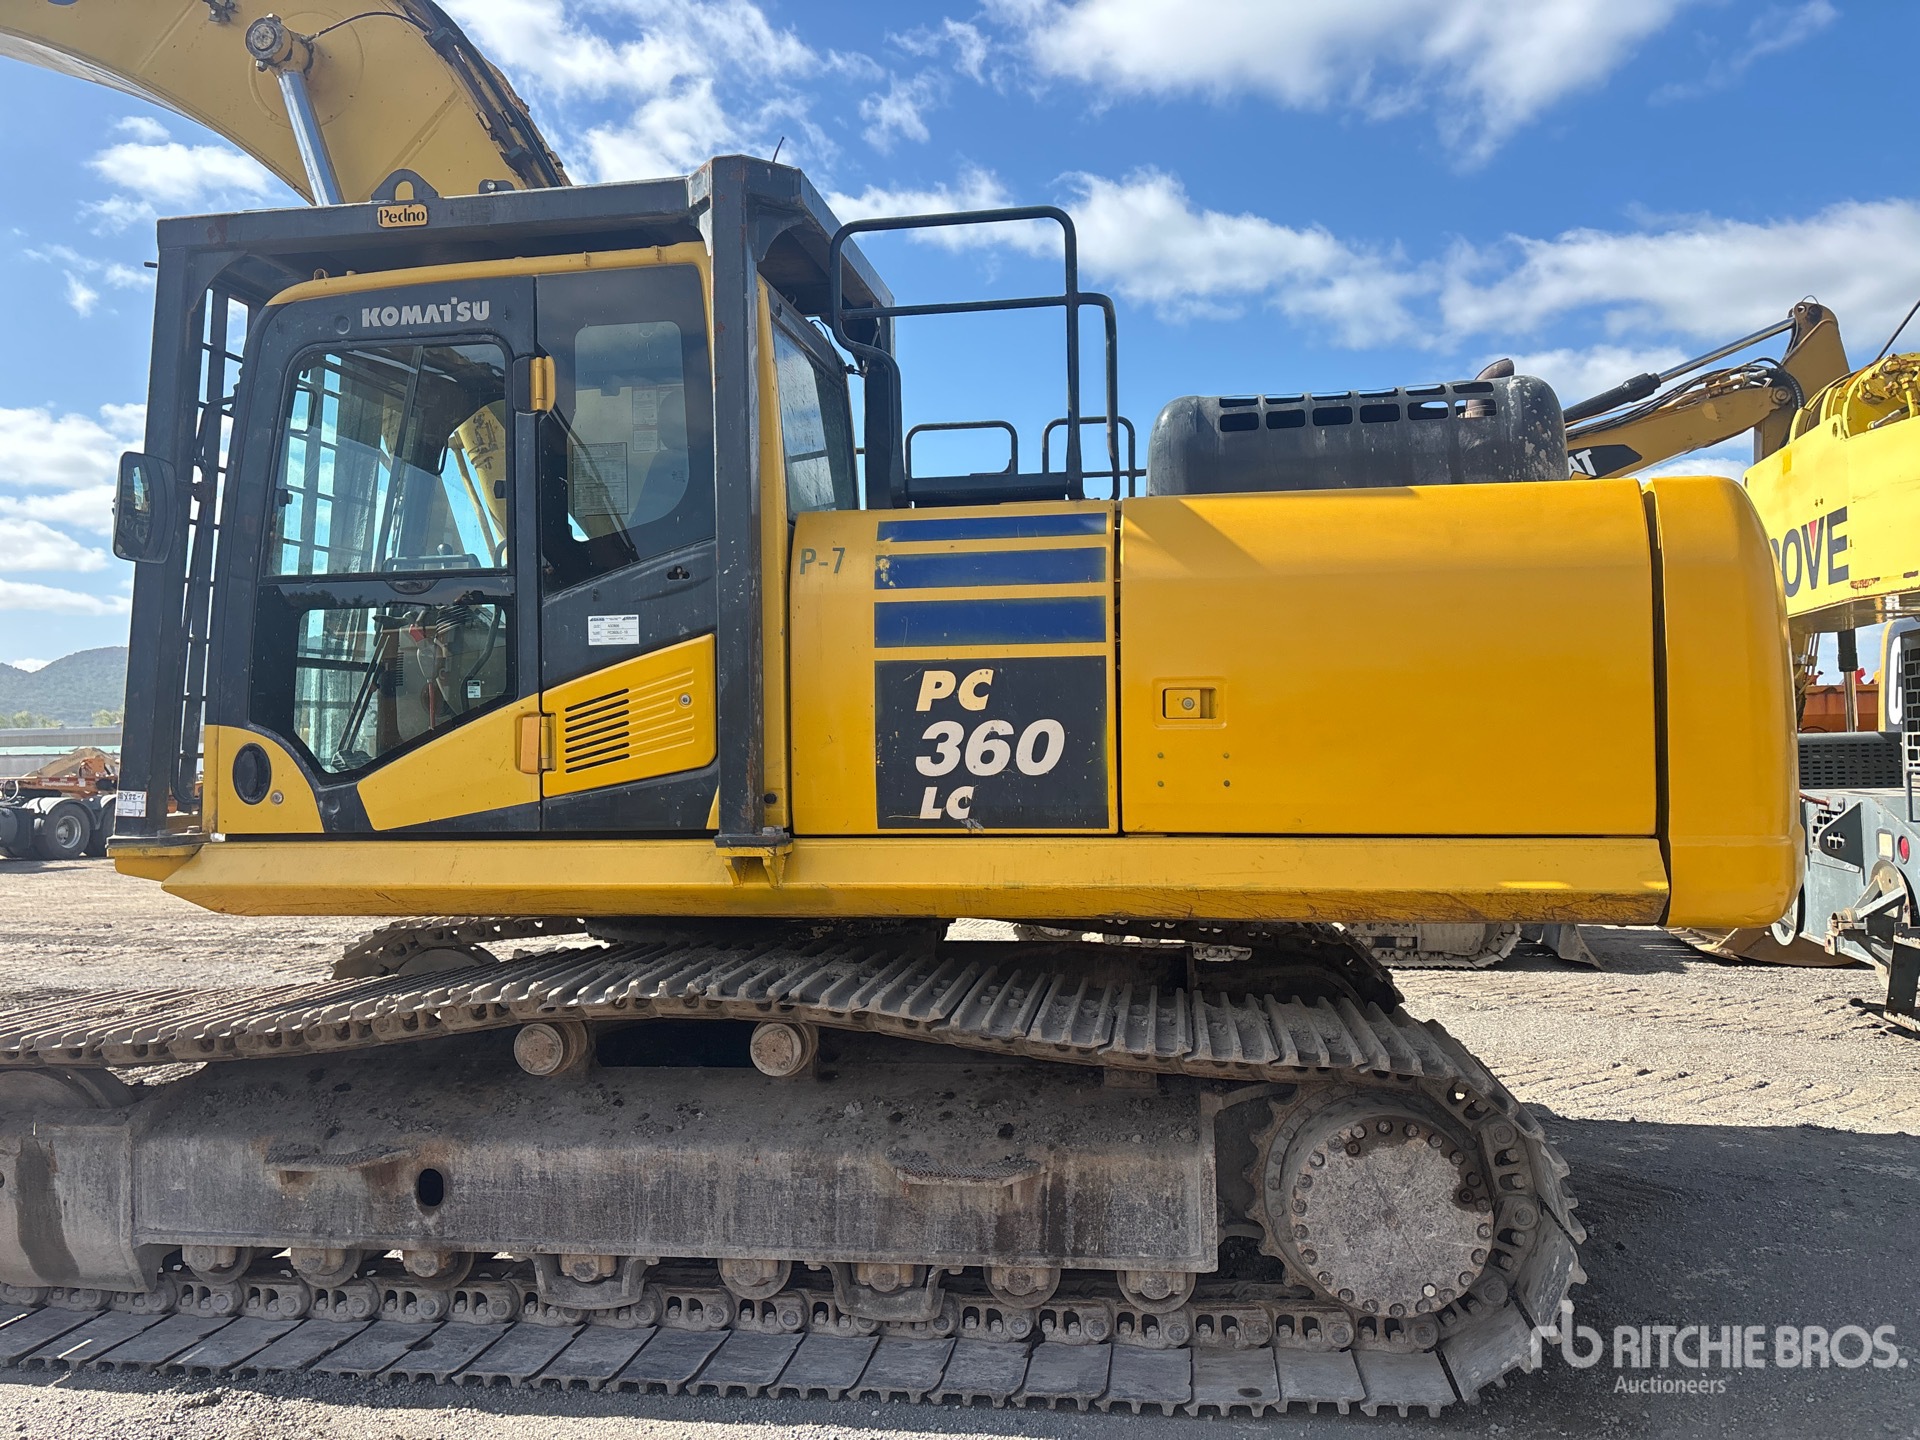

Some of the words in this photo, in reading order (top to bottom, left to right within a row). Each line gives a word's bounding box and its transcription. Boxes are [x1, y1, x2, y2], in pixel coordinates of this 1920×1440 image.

[361, 297, 490, 328] KOMATSU
[1568, 449, 1597, 479] AT
[800, 547, 846, 575] P-7
[1770, 506, 1849, 597] OVE
[916, 668, 995, 712] PC
[915, 718, 1066, 777] 360
[919, 785, 975, 820] LC
